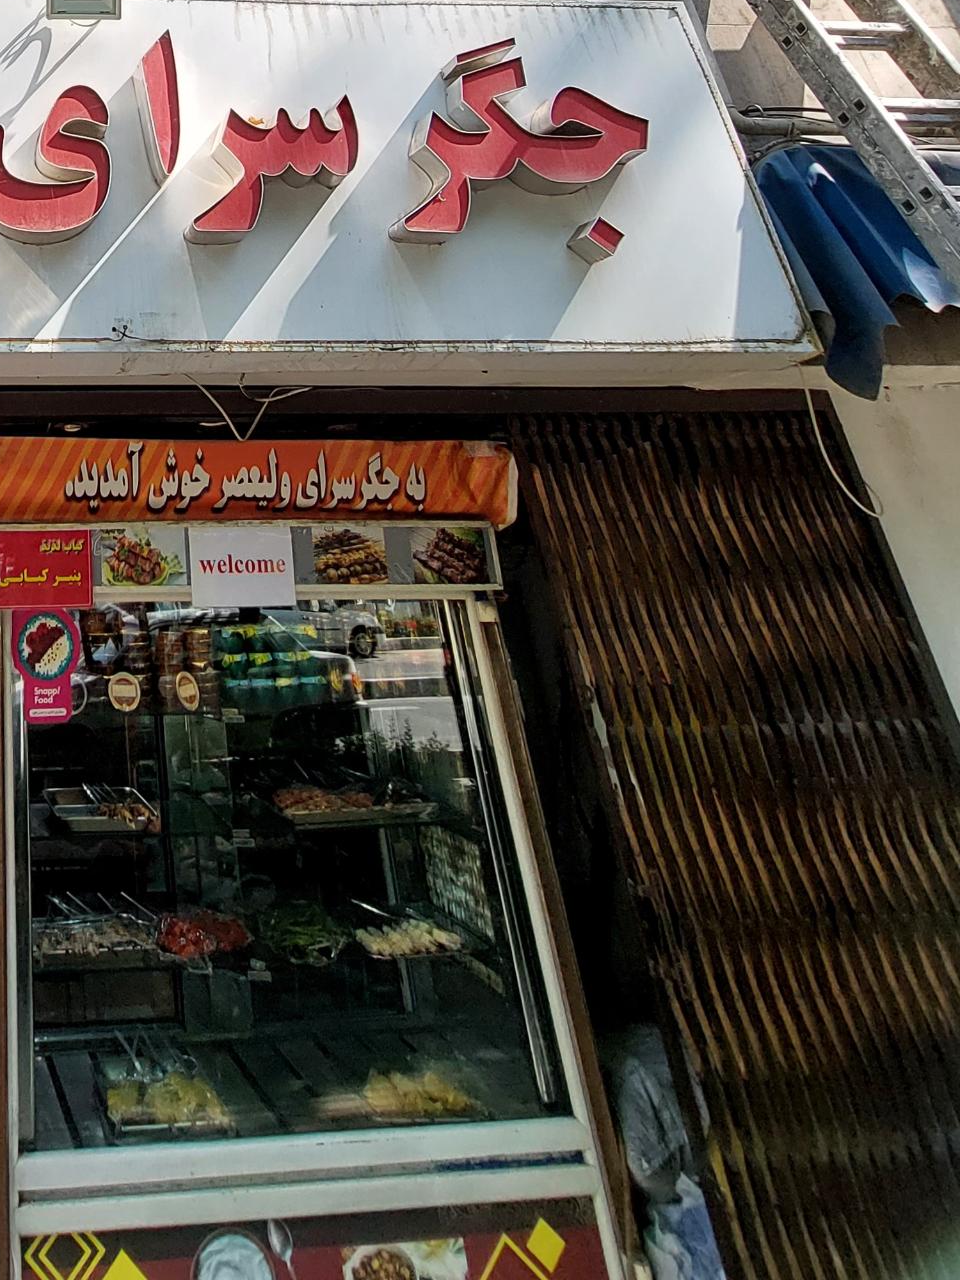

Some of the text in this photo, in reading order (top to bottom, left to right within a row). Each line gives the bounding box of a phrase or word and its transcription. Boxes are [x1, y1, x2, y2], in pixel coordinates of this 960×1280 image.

[148, 447, 211, 509] خوش
[213, 447, 291, 509] ولیعصر
[406, 461, 427, 512] به
[63, 538, 85, 556] کباب
[199, 553, 286, 574] welcome
[0, 568, 82, 588] پنیر کبابی
[34, 695, 54, 704] Food
